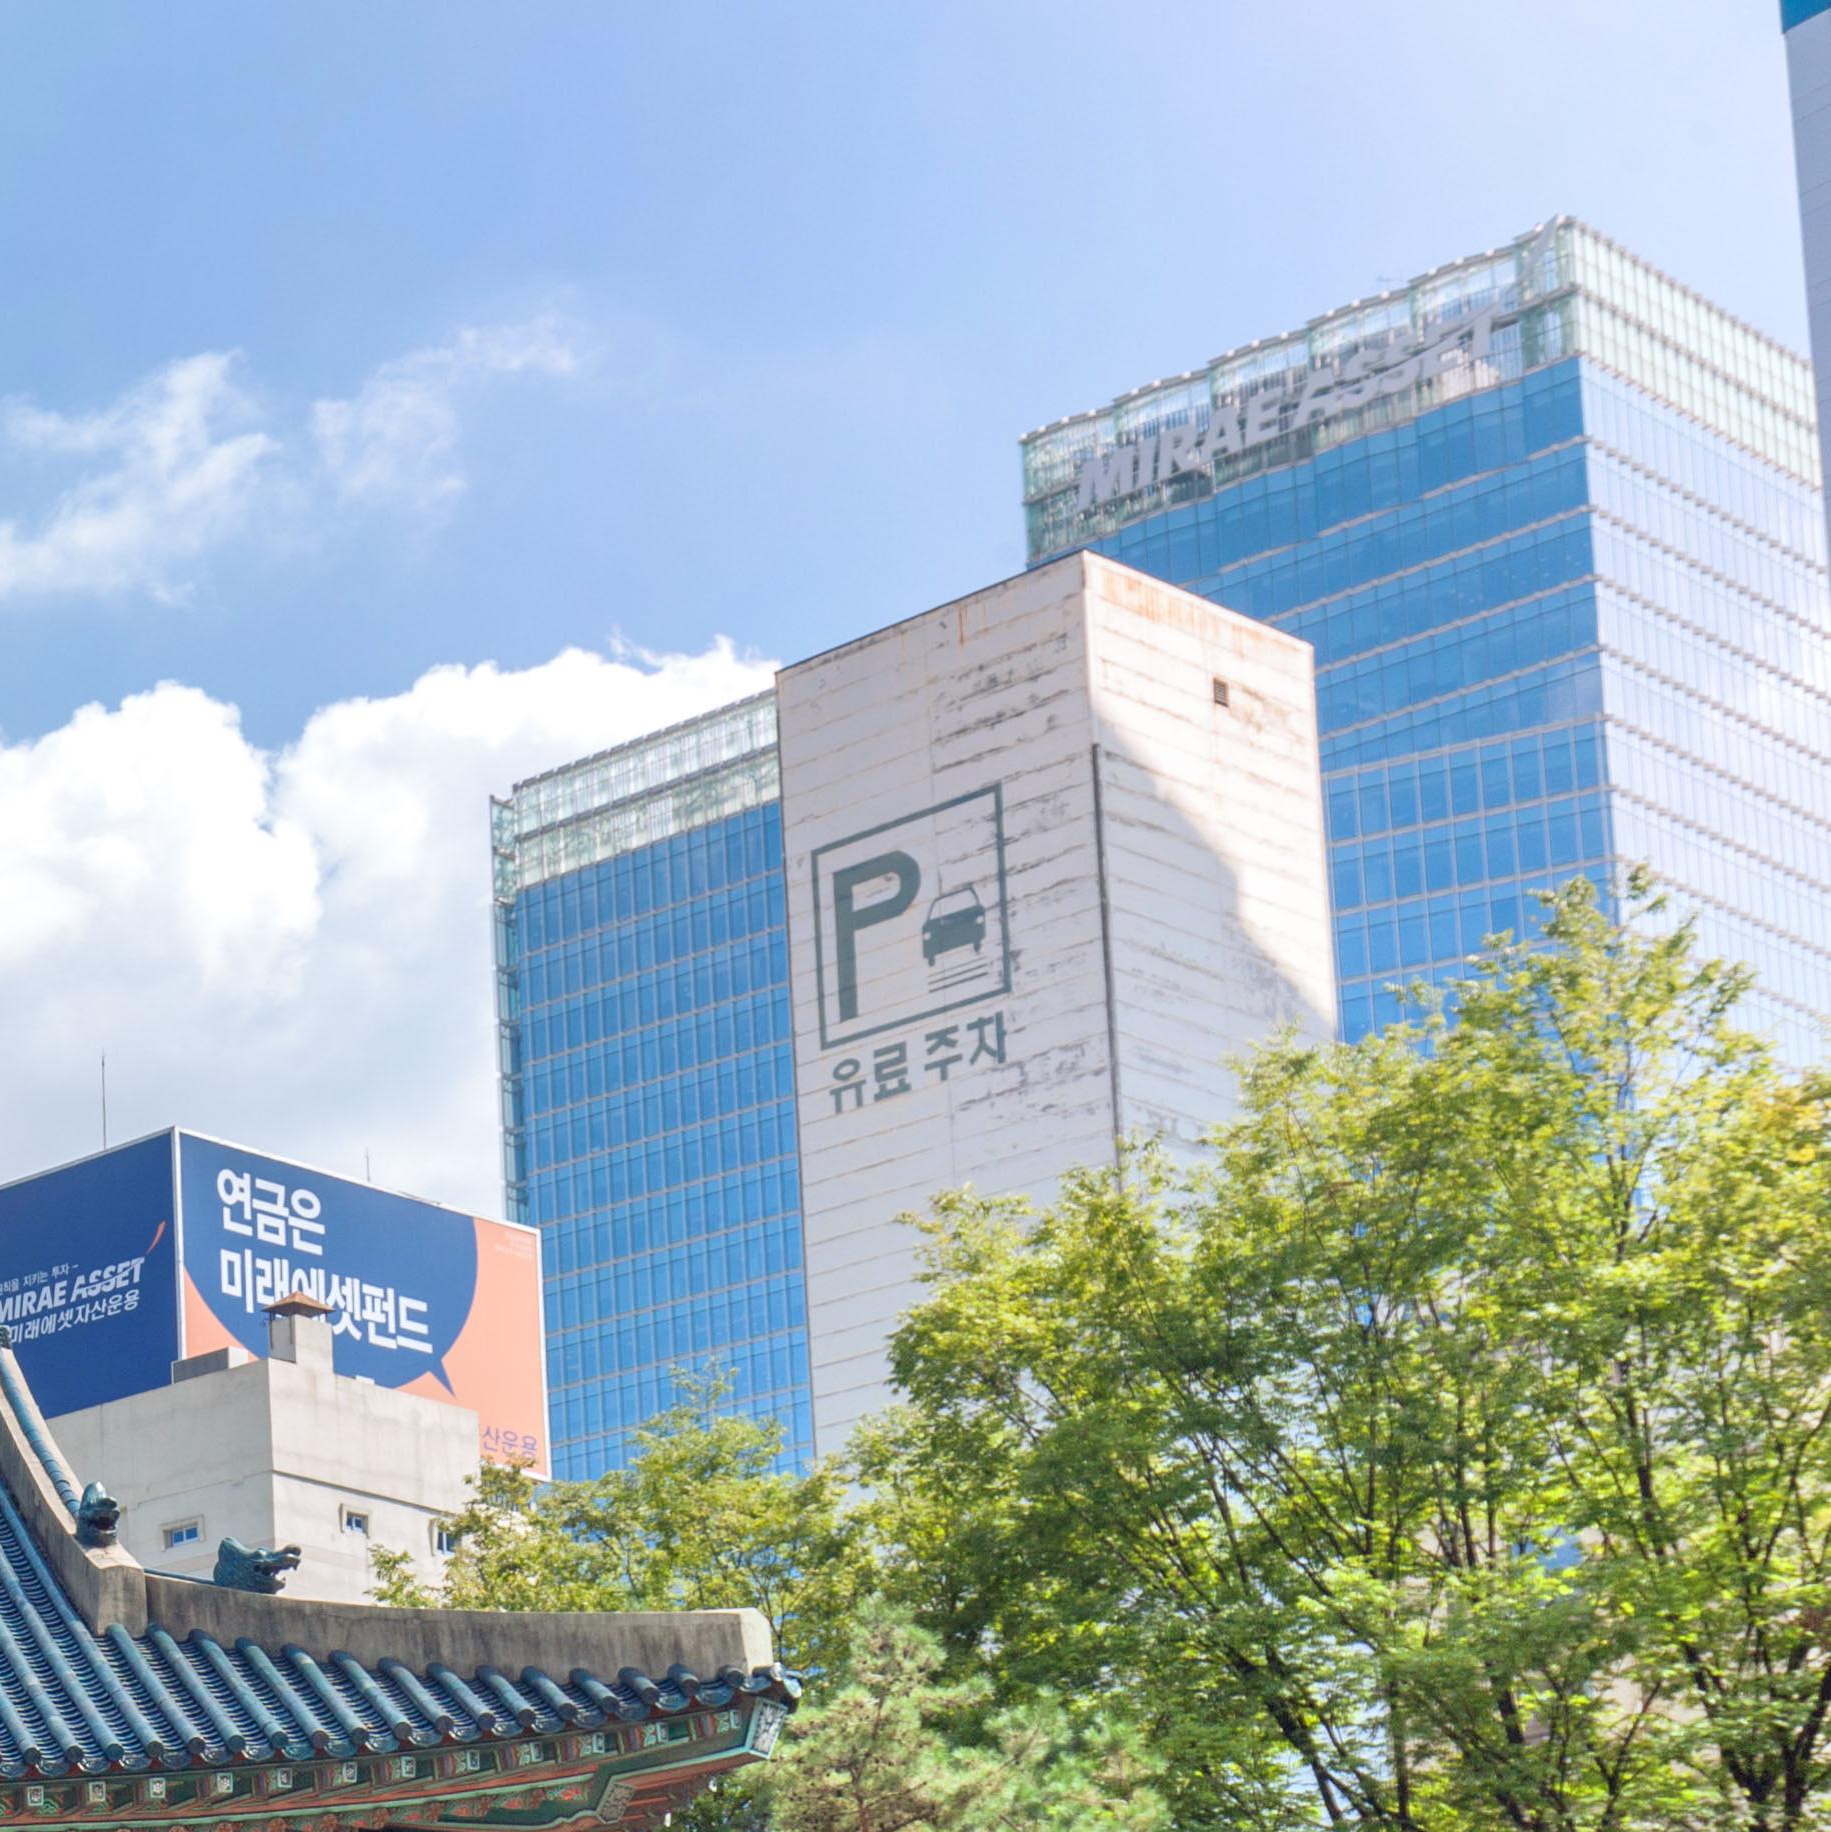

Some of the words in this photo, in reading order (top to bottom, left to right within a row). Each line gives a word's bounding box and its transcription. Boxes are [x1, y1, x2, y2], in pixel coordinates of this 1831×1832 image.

[1078, 388, 1297, 510] MIRAE
[1291, 303, 1503, 428] ASSET
[832, 849, 922, 1023] P
[216, 1168, 326, 1256] 연금은
[23, 1271, 48, 1287] 지키는
[51, 1262, 70, 1279] 투자
[70, 1256, 146, 1302] ASSET
[219, 1248, 434, 1354] 미래에셋펀드
